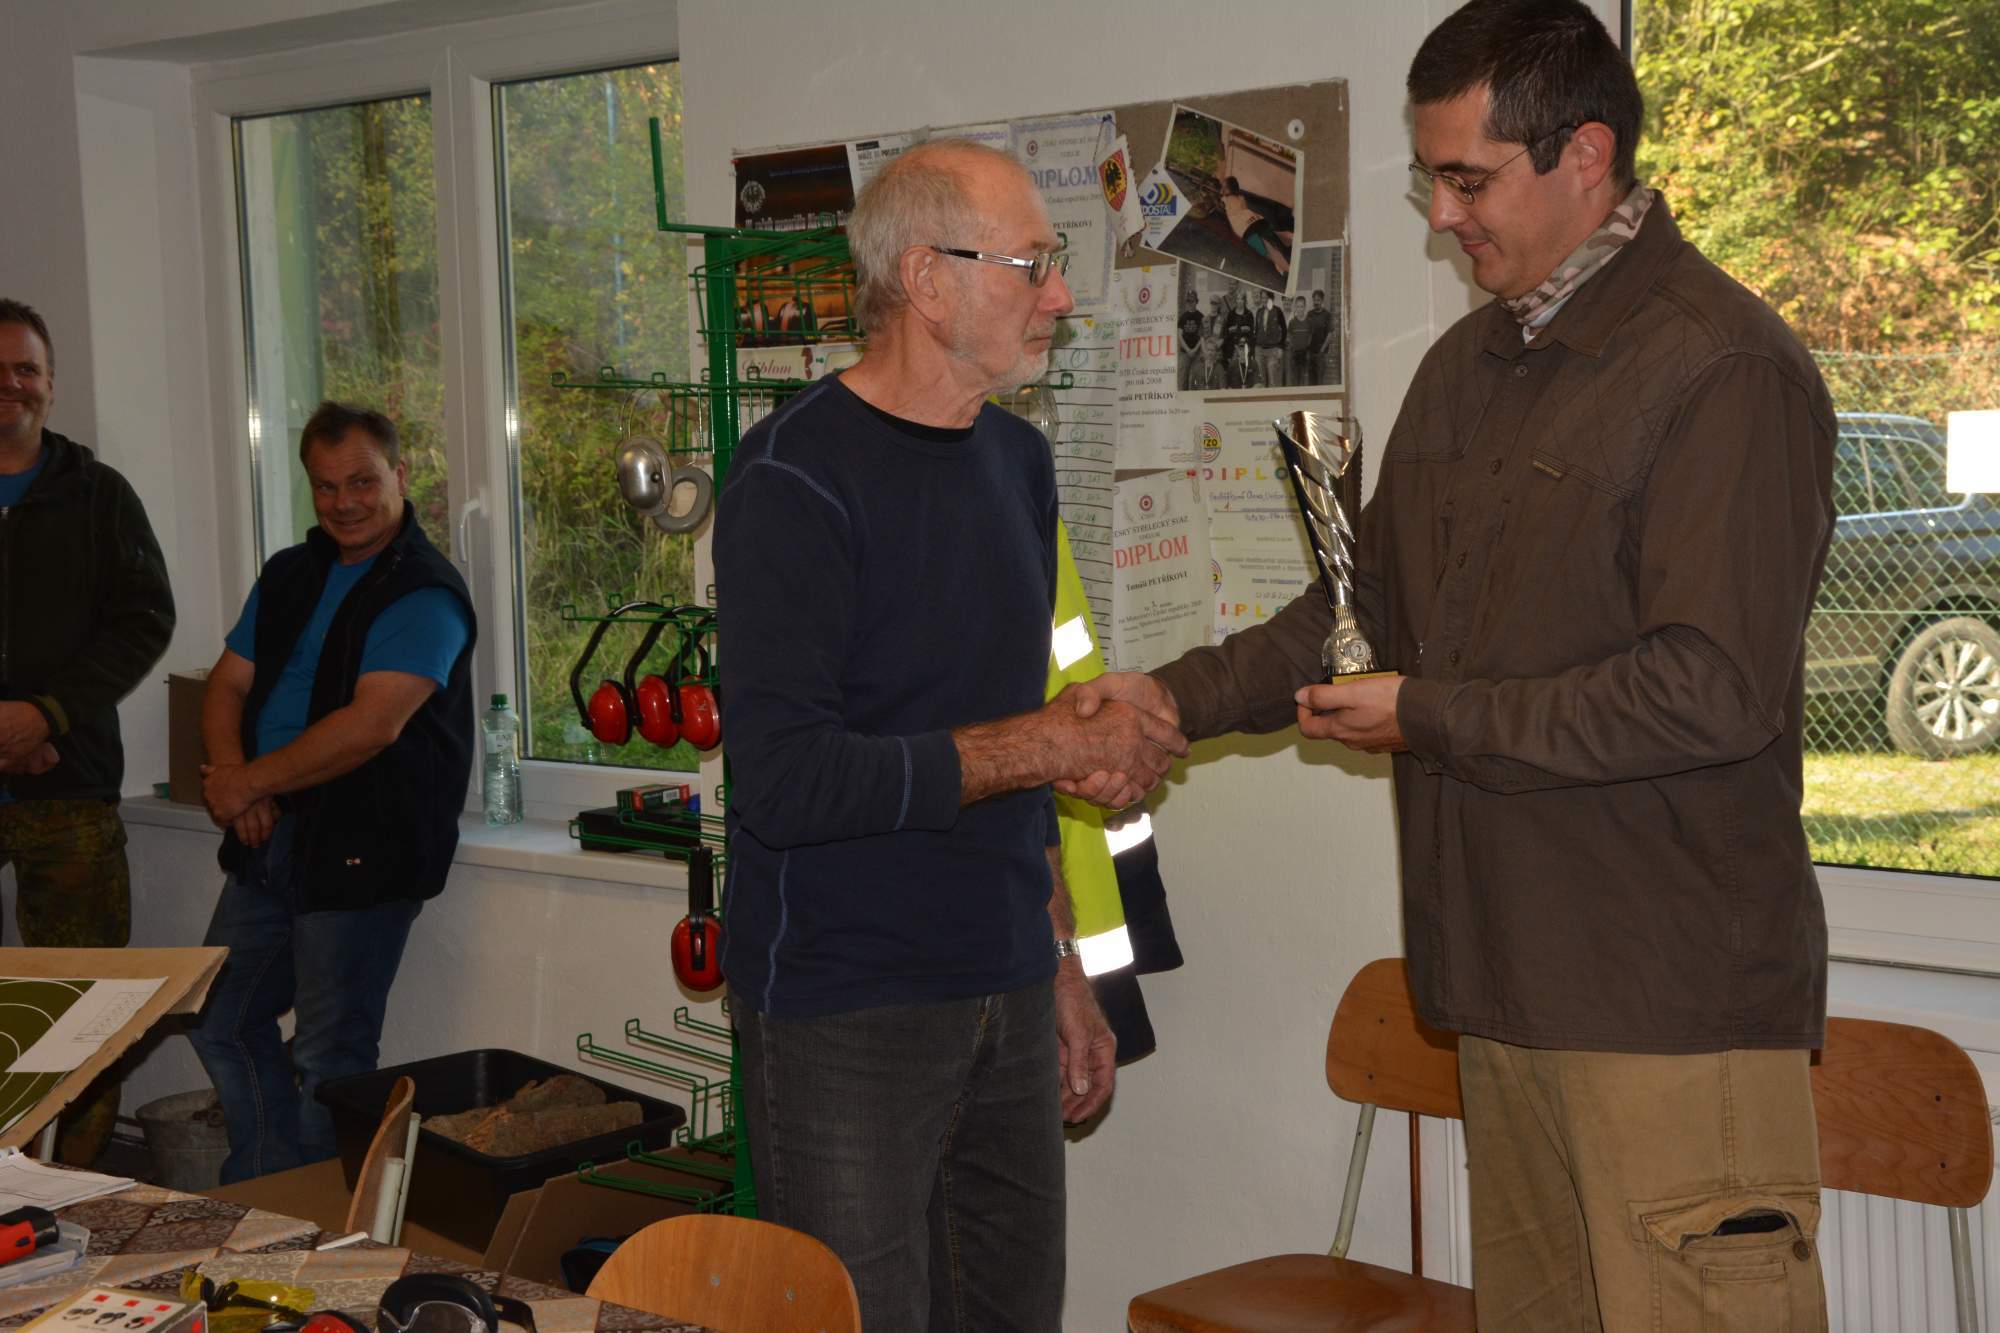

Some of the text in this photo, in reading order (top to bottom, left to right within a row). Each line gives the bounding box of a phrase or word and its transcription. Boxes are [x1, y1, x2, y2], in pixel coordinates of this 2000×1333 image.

[1031, 165, 1098, 189] DIPLOM
[1202, 467, 1289, 481] DIPLO
[1114, 535, 1189, 569] DIPLOM
